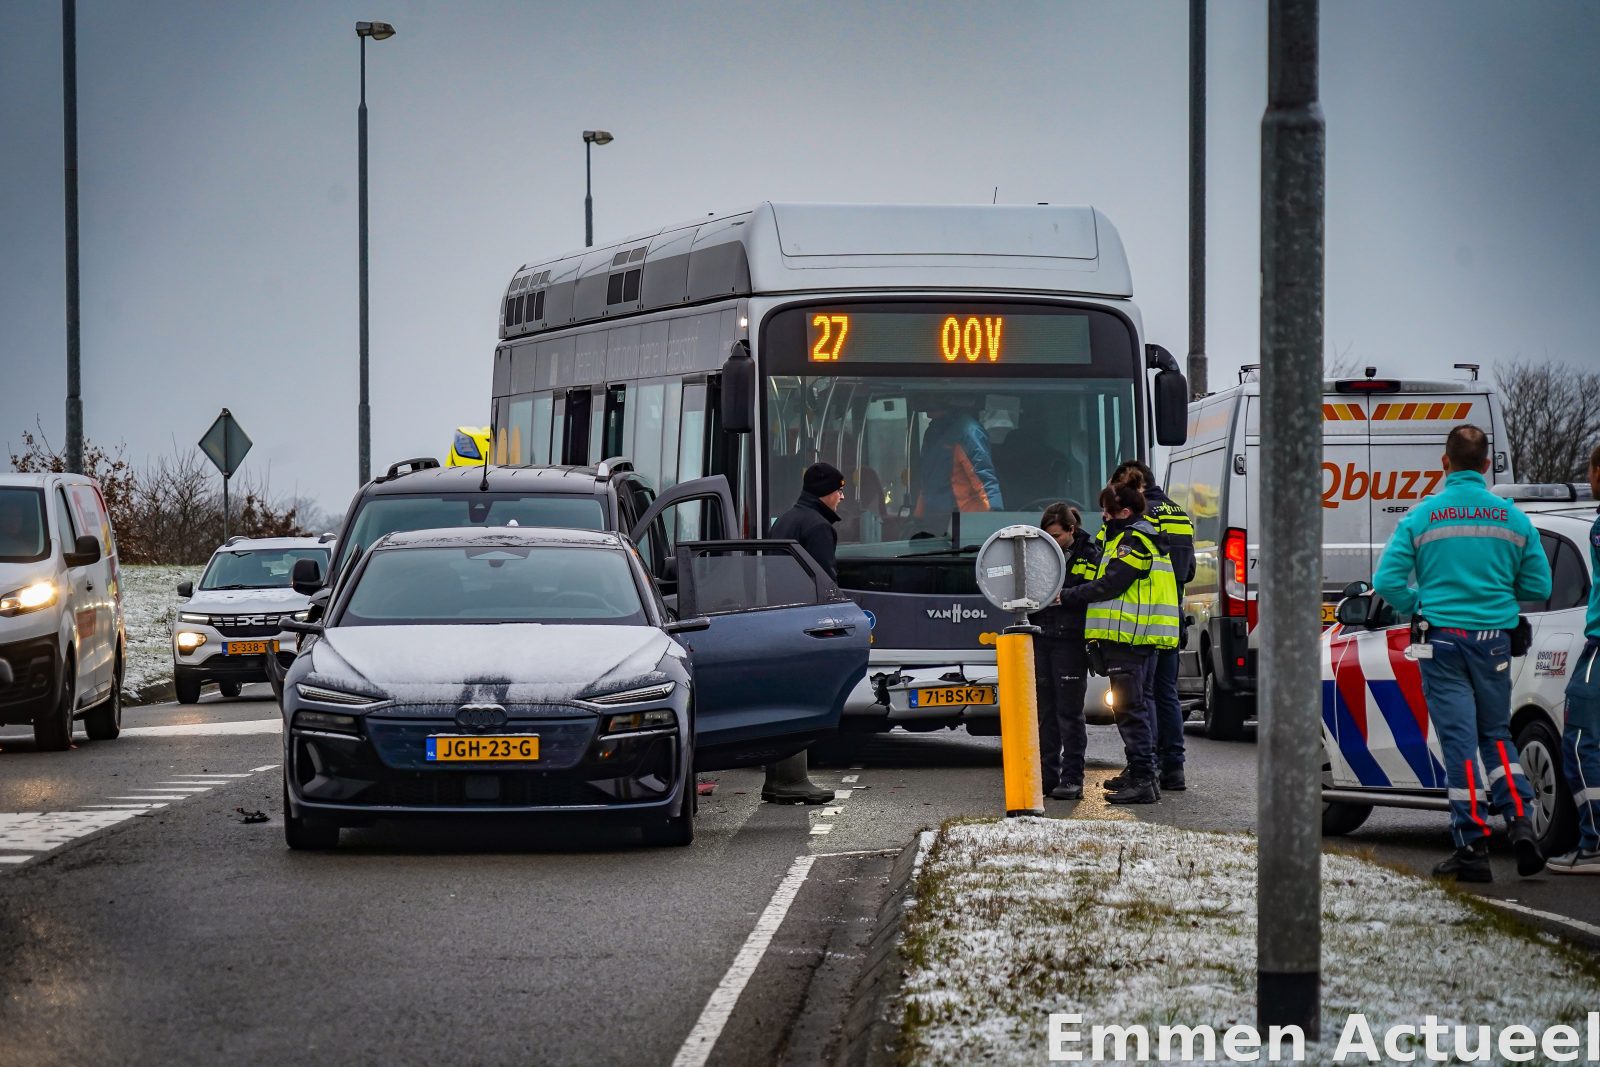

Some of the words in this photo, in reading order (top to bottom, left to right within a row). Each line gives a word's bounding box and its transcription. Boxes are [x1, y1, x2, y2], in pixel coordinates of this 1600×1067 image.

[813, 315, 848, 360] 27
[1429, 507, 1509, 523] AMBULANCE
[1552, 651, 1568, 667] 112
[925, 689, 986, 704] 71-BSK-7
[443, 740, 531, 757] JGH-23-G
